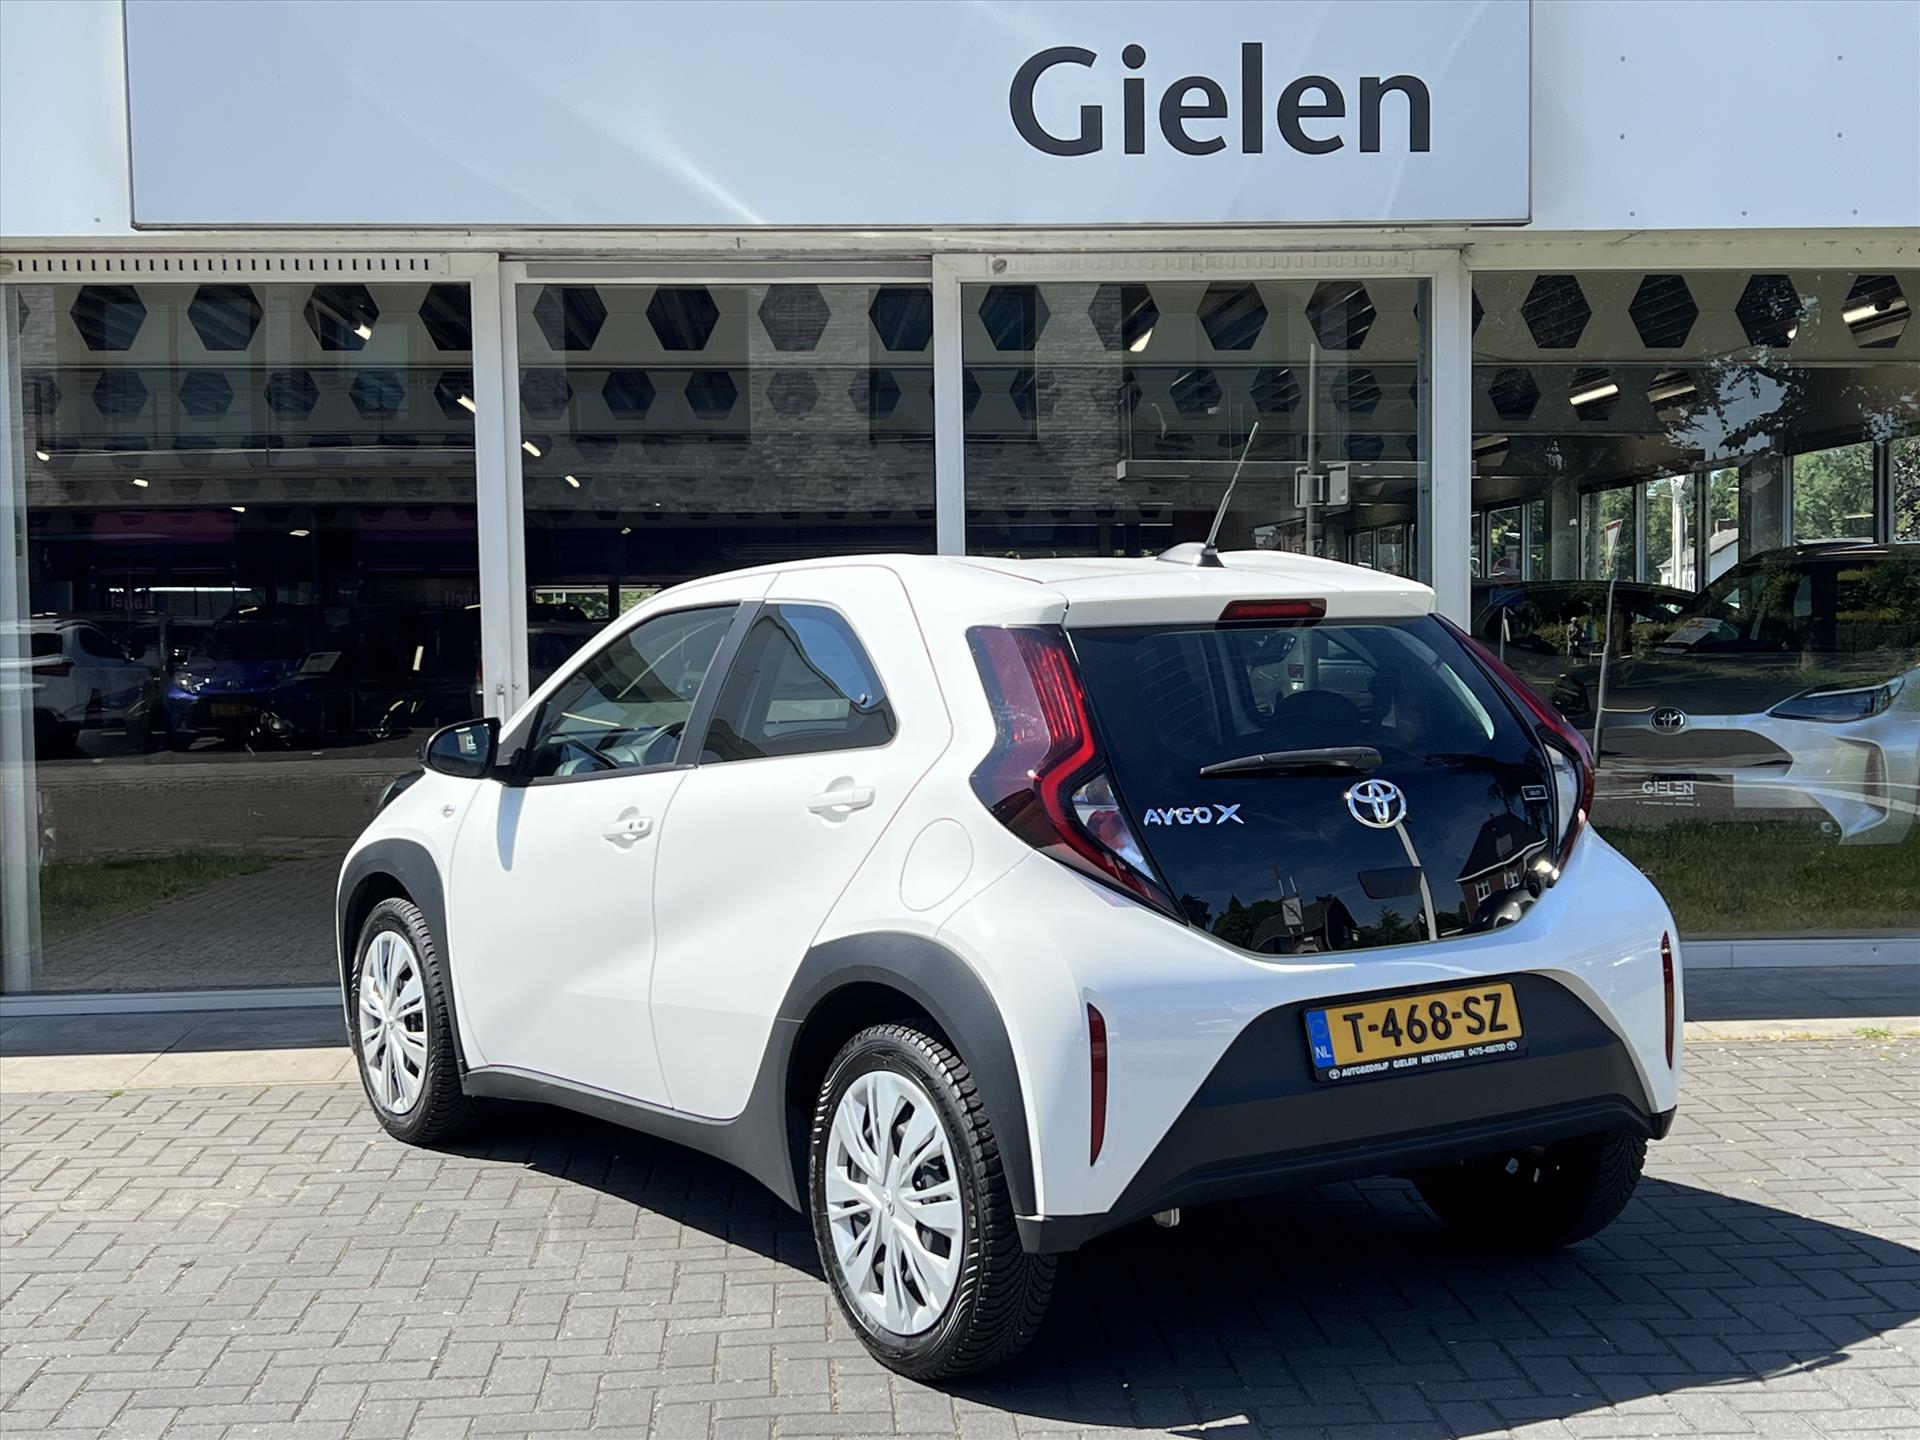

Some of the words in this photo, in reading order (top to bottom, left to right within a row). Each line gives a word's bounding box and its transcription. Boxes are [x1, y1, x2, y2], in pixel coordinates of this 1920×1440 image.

[1009, 42, 1430, 157] Gielen
[1641, 781, 1695, 795] GIELEN
[1342, 993, 1509, 1053] T-468-SZ
[1314, 1045, 1332, 1060] NL
[1341, 1061, 1389, 1077] AUTOBEDRIJF
[1393, 1057, 1418, 1069] GIELEN
[1421, 1049, 1465, 1064] HEYTHUYSEN
